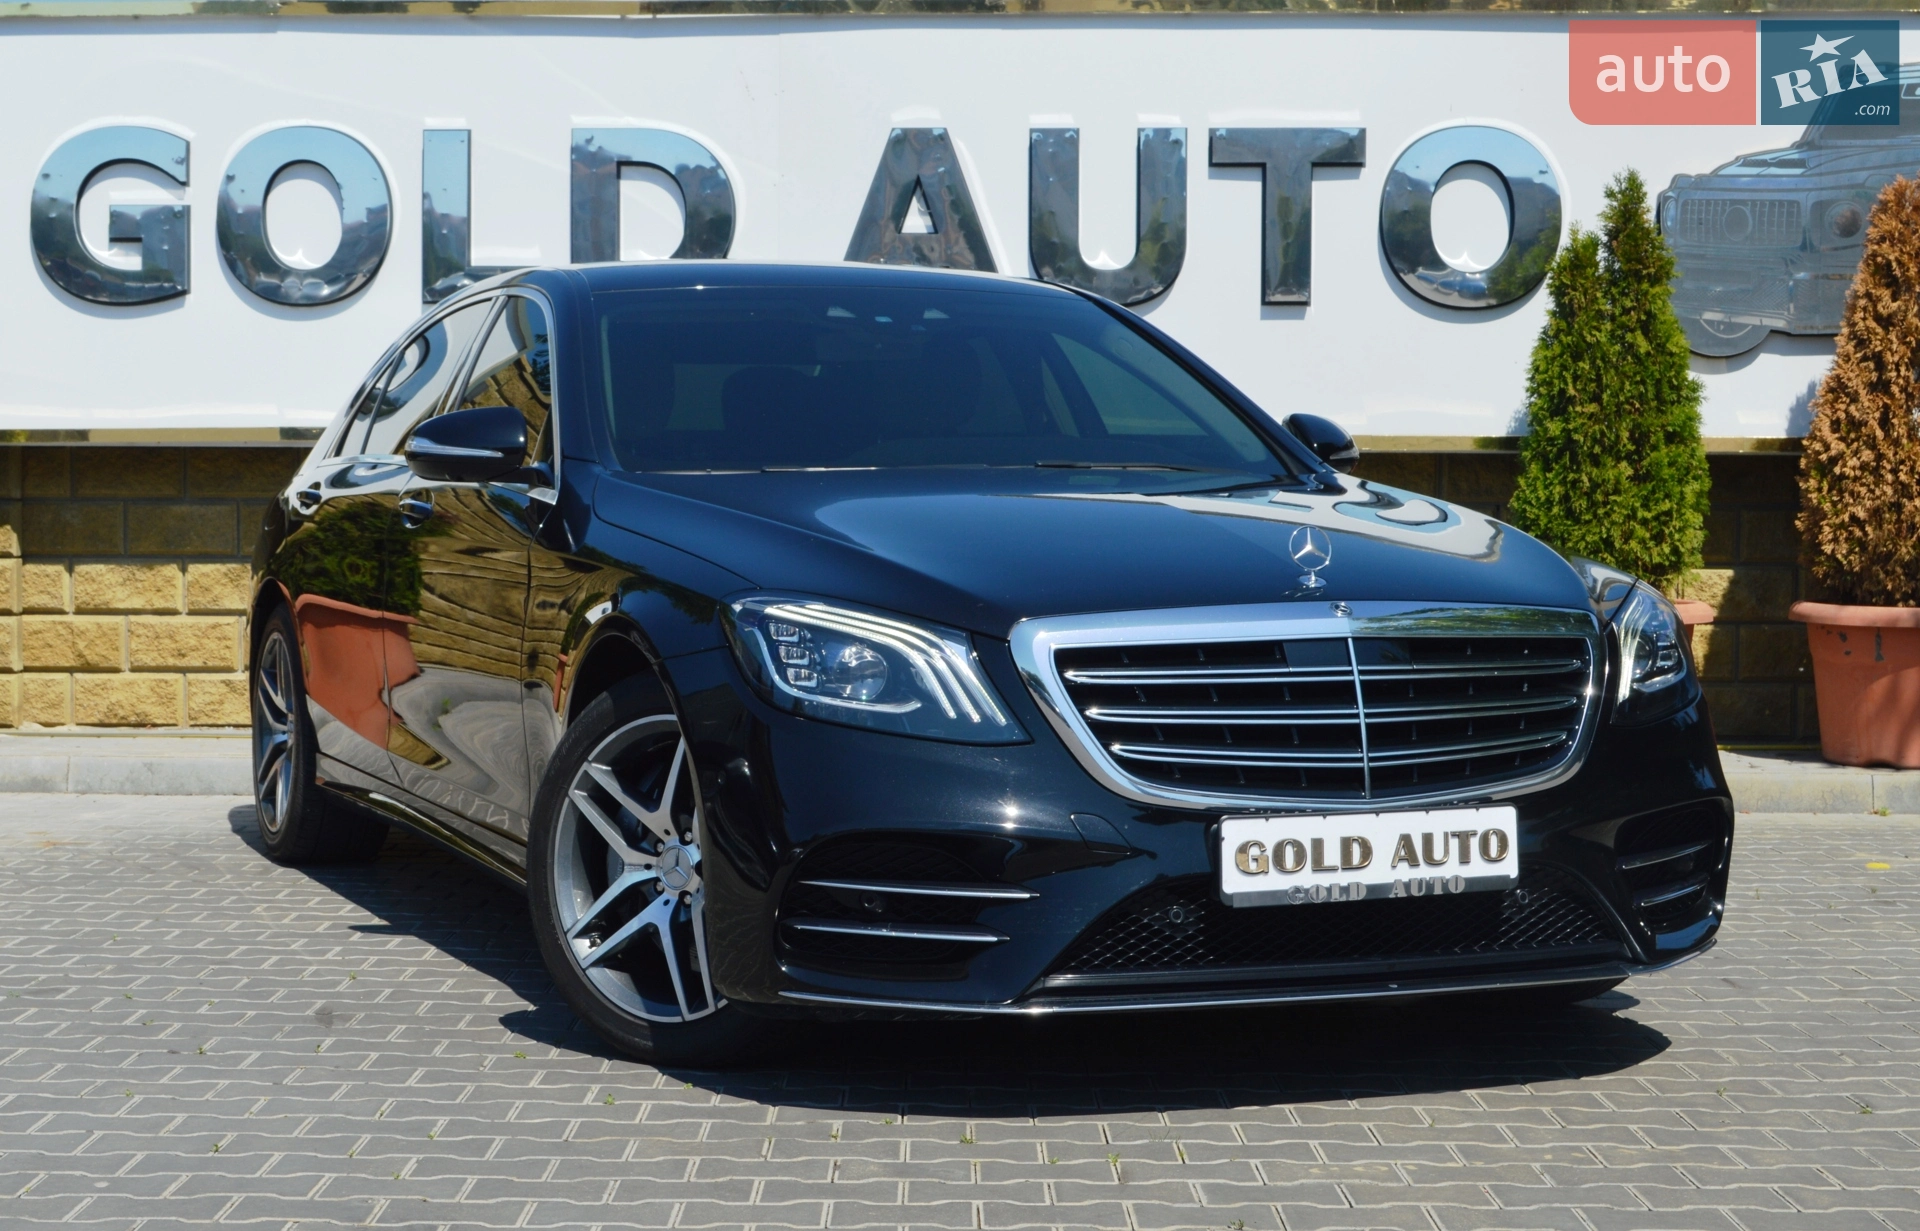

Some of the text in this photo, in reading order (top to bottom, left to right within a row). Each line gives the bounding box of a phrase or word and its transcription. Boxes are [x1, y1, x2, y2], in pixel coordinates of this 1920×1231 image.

[30, 125, 1563, 310] GOLD AUTO
[1235, 828, 1510, 874] GOLD AUTO
[1286, 874, 1466, 905] GOLD AUTO
